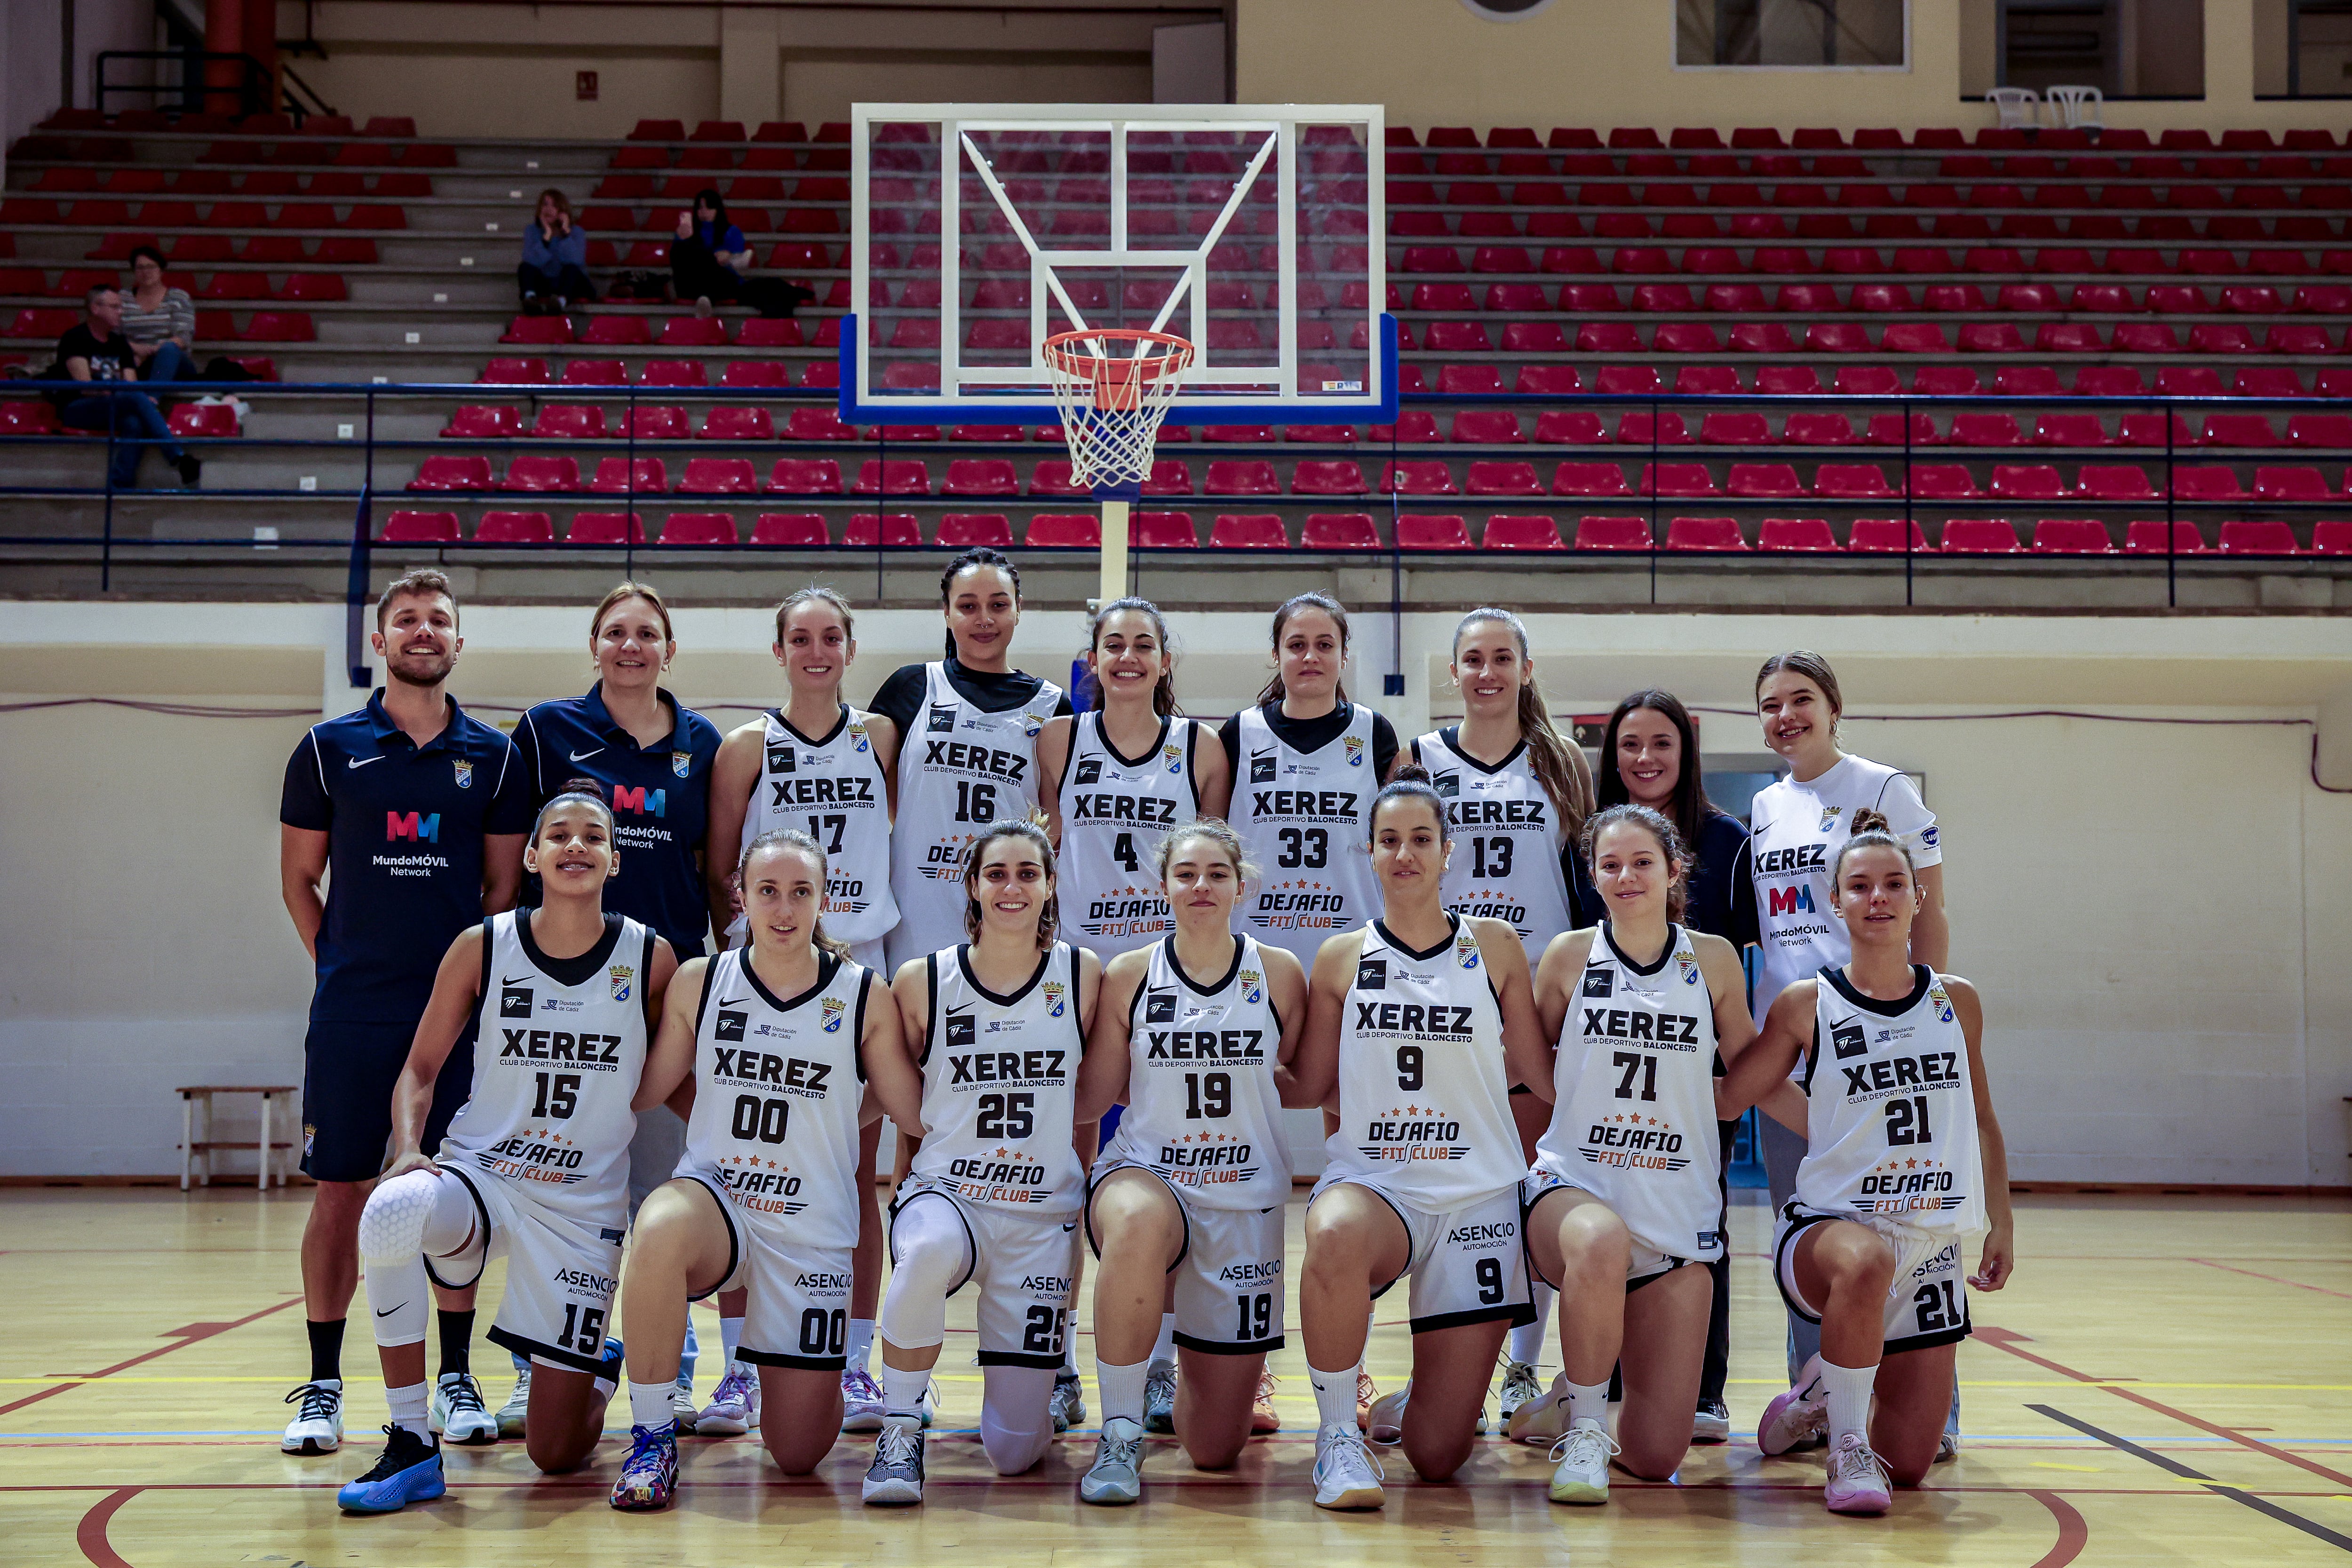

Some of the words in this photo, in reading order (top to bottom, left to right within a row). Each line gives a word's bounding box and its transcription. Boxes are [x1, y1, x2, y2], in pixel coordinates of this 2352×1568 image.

[924, 740, 1027, 781] XEREZ
[940, 767, 976, 777] DEPORTIVO
[771, 778, 874, 806] XEREZ
[955, 781, 996, 823] 16
[1074, 794, 1176, 823] XEREZ
[1252, 791, 1358, 817] XEREZ
[1308, 816, 1358, 825] BALONCESTO
[615, 826, 672, 841] ndoMÓVIL
[808, 814, 847, 855] 17
[1113, 833, 1138, 872] 4
[1278, 828, 1328, 869] 33
[1472, 836, 1514, 878] 13
[373, 854, 448, 867] MundoMÓVIL
[391, 868, 430, 876] Network
[1791, 866, 1826, 876] BALONCESTO
[826, 901, 851, 913] LUB
[1089, 899, 1170, 919] DESAFIO
[1259, 894, 1343, 912] DESAFIO
[1101, 923, 1123, 935] FIT
[1132, 921, 1164, 933] CLUB
[1270, 916, 1292, 927] FIT
[1299, 916, 1331, 928] CLUB
[1356, 1002, 1473, 1035] XEREZ
[1583, 1009, 1698, 1044] XEREZ
[1891, 1026, 1915, 1034] Diputación
[500, 1028, 622, 1064] XEREZ
[1147, 1030, 1263, 1059] XEREZ
[1415, 1033, 1472, 1043] BALONCESTO
[1599, 1038, 1641, 1048] DEPORTIVO
[1643, 1042, 1697, 1052] BALONCESTO
[520, 1060, 563, 1069] DEPORTIVO
[564, 1062, 617, 1073] BALONCESTO
[714, 1047, 832, 1092] XEREZ
[948, 1050, 1065, 1084] XEREZ
[1209, 1059, 1263, 1067] BALONCESTO
[1397, 1046, 1423, 1091] 9
[1841, 1052, 1959, 1097] XEREZ
[969, 1082, 1010, 1090] DEPORTIVO
[1012, 1079, 1065, 1088] BALONCESTO
[1613, 1051, 1657, 1102] 71
[532, 1072, 581, 1119] 15
[728, 1080, 770, 1090] DEPORTIVO
[771, 1085, 825, 1099] BALONCESTO
[1185, 1072, 1231, 1119] 19
[1848, 1095, 1867, 1104] CLUB
[1869, 1088, 1911, 1100] DEPORTIVO
[1913, 1081, 1960, 1093] BALONCESTO
[731, 1094, 789, 1144] 00
[977, 1093, 1034, 1139] 25
[1885, 1096, 1932, 1146] 21
[1368, 1122, 1459, 1141] DESAFIO
[1588, 1125, 1683, 1153] DESAFIO
[489, 1139, 583, 1169] DESAFIO
[1160, 1145, 1251, 1166] DESAFIO
[1382, 1147, 1404, 1160] FIT
[1412, 1147, 1448, 1160] CLUB
[1599, 1151, 1625, 1165] FIT
[1632, 1154, 1667, 1170] CLUB
[493, 1160, 520, 1176] FIT
[525, 1168, 564, 1183] CLUB
[950, 1159, 1044, 1185] DESAFIO
[1171, 1170, 1196, 1184] FIT
[1203, 1170, 1238, 1185] CLUB
[1861, 1171, 1953, 1194] DESAFIO
[959, 1183, 986, 1198] FIT
[993, 1186, 1030, 1202] CLUB
[1875, 1200, 1901, 1212] FIT
[1910, 1196, 1941, 1210] CLUB
[747, 1198, 784, 1214] CLUB
[1446, 1222, 1515, 1243] ASENCIO
[1462, 1239, 1507, 1251] AUTOMOCIÓN
[554, 1267, 617, 1294] ASENCIO
[794, 1274, 852, 1288] ASENCIO
[1219, 1259, 1280, 1281] ASENCIO
[1475, 1257, 1504, 1305] 9
[1020, 1275, 1072, 1292] ASENC
[1235, 1278, 1273, 1288] AUTOMOCIÓN
[1236, 1292, 1271, 1340] 19
[1913, 1279, 1961, 1333] 21
[556, 1303, 605, 1356] 15
[799, 1308, 846, 1355] 00
